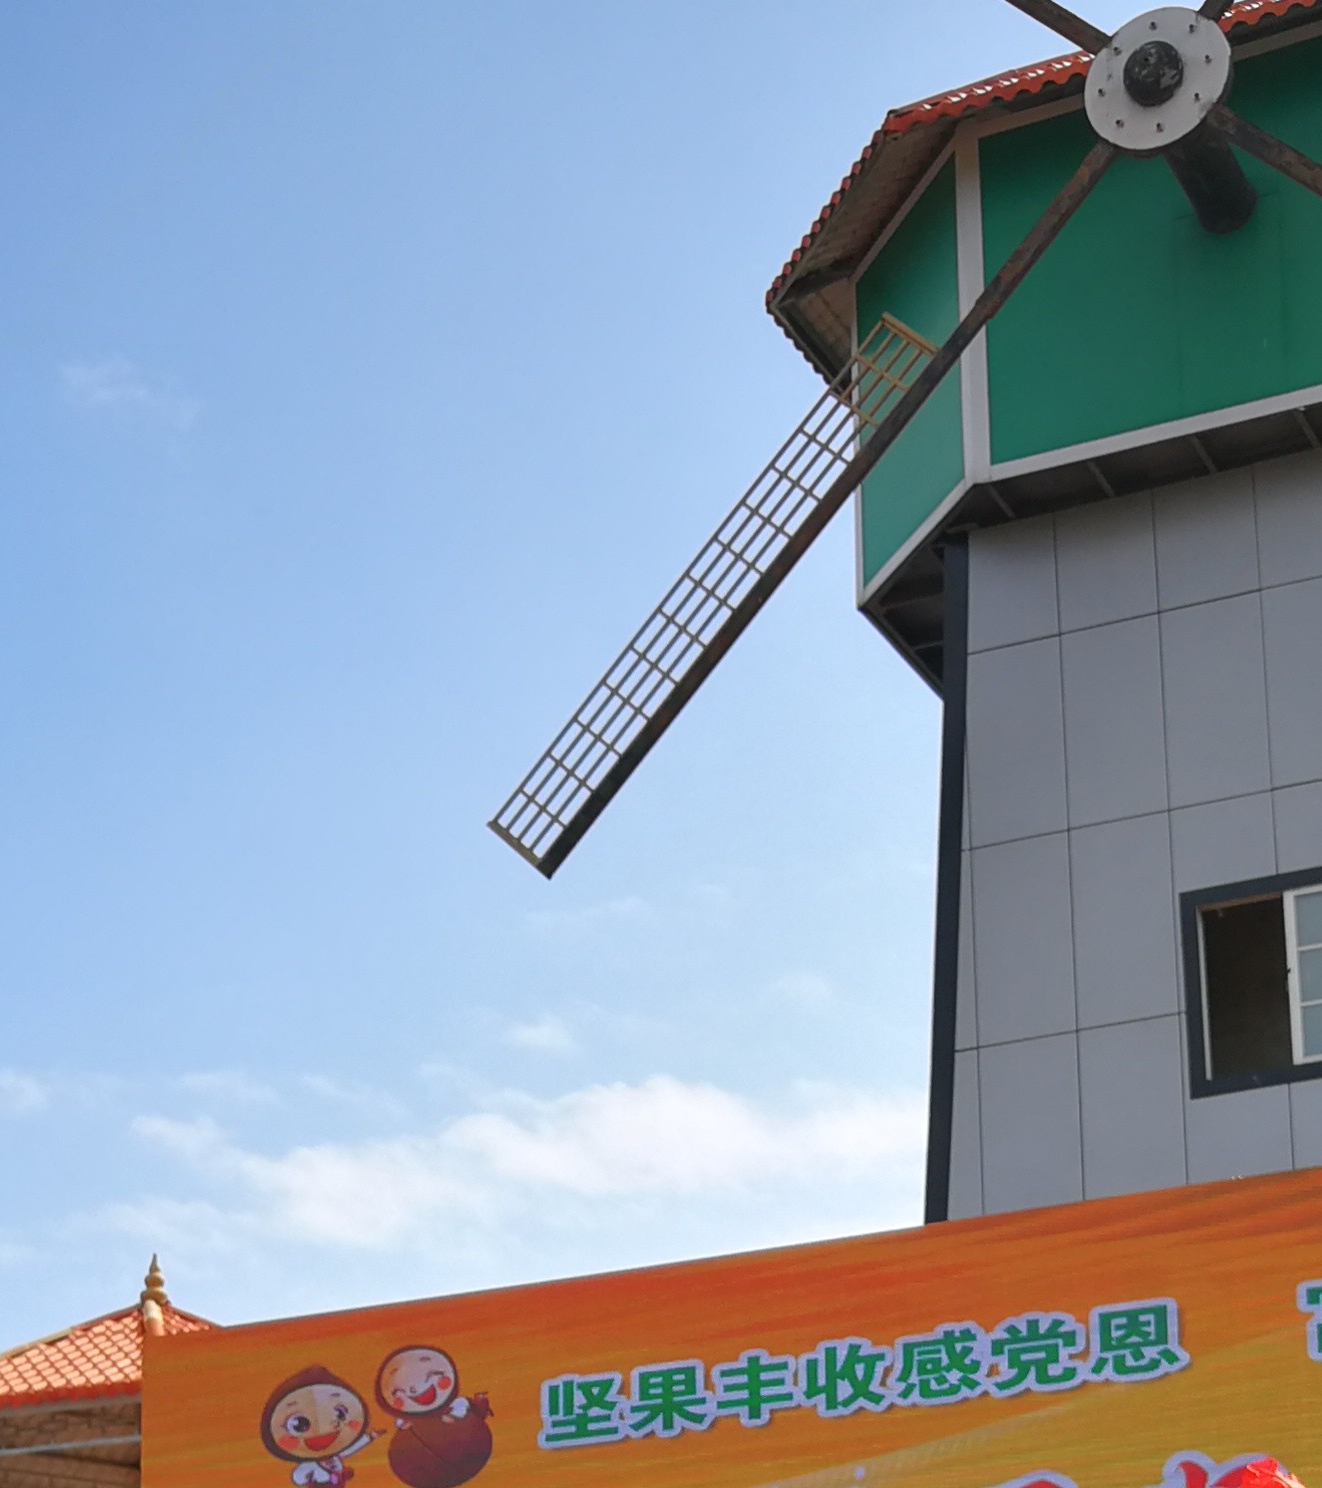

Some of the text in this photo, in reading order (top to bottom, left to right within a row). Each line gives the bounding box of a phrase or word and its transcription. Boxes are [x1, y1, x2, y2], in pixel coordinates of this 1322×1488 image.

[544, 1304, 1181, 1443] 坚果丰收感党恩
